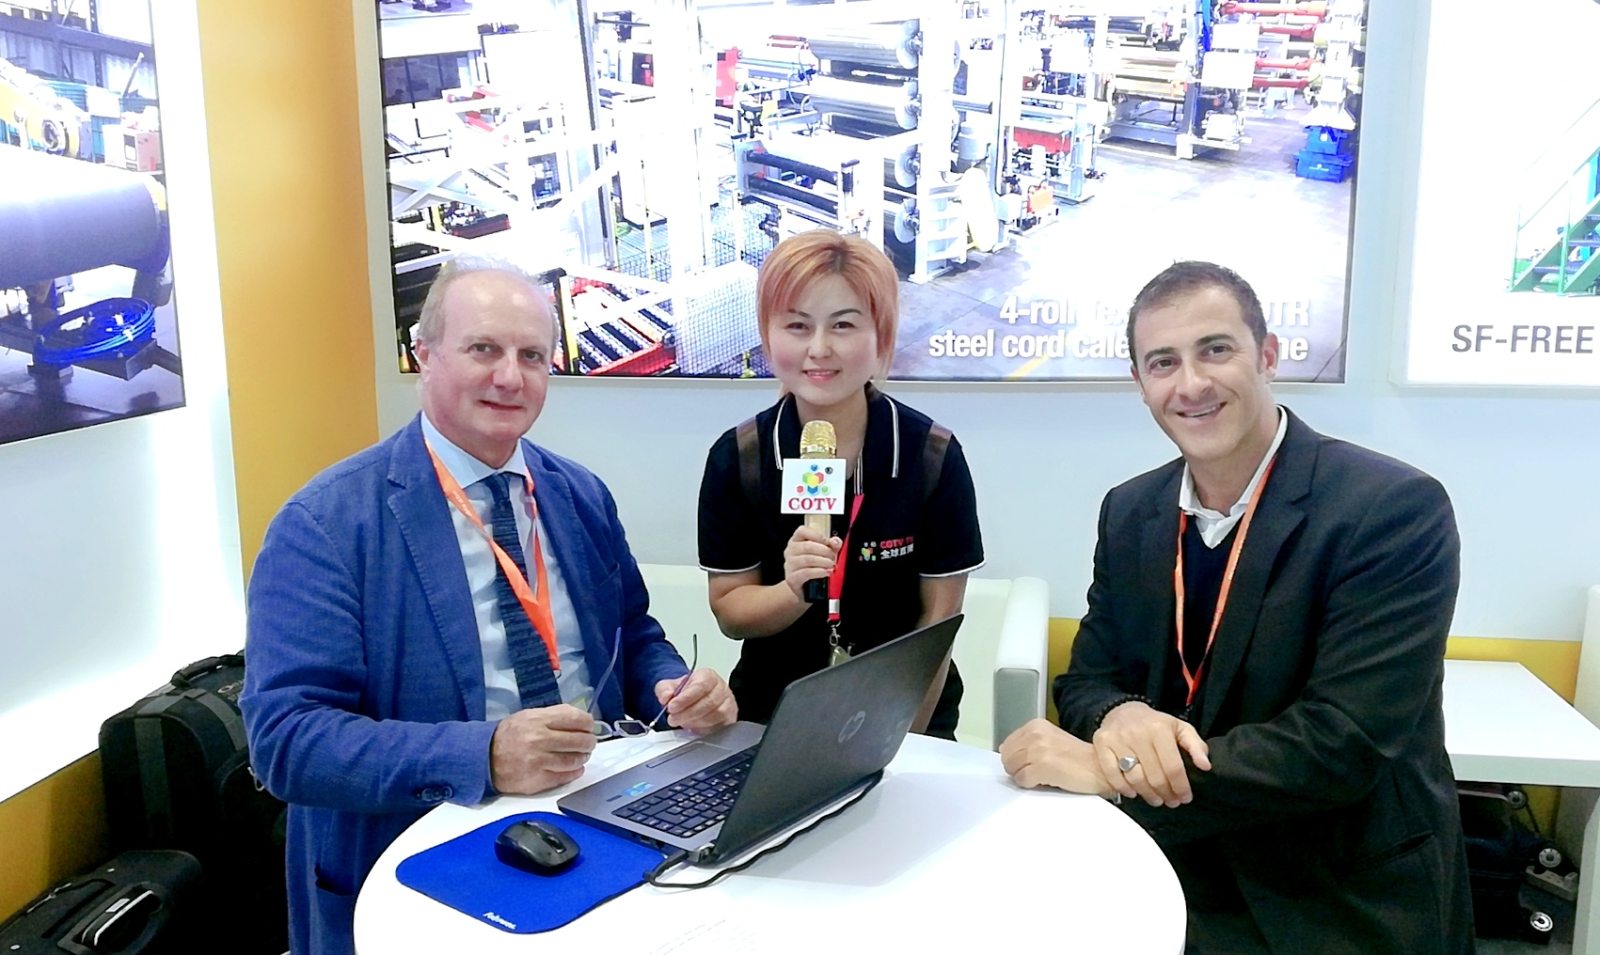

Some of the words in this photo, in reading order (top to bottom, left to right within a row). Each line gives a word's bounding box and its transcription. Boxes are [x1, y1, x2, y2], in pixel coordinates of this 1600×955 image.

[1000, 295, 1076, 325] 4-roll
[928, 329, 995, 358] steel
[1002, 329, 1066, 358] cord
[1452, 324, 1595, 354] SF-FREE
[788, 497, 837, 511] COTV
